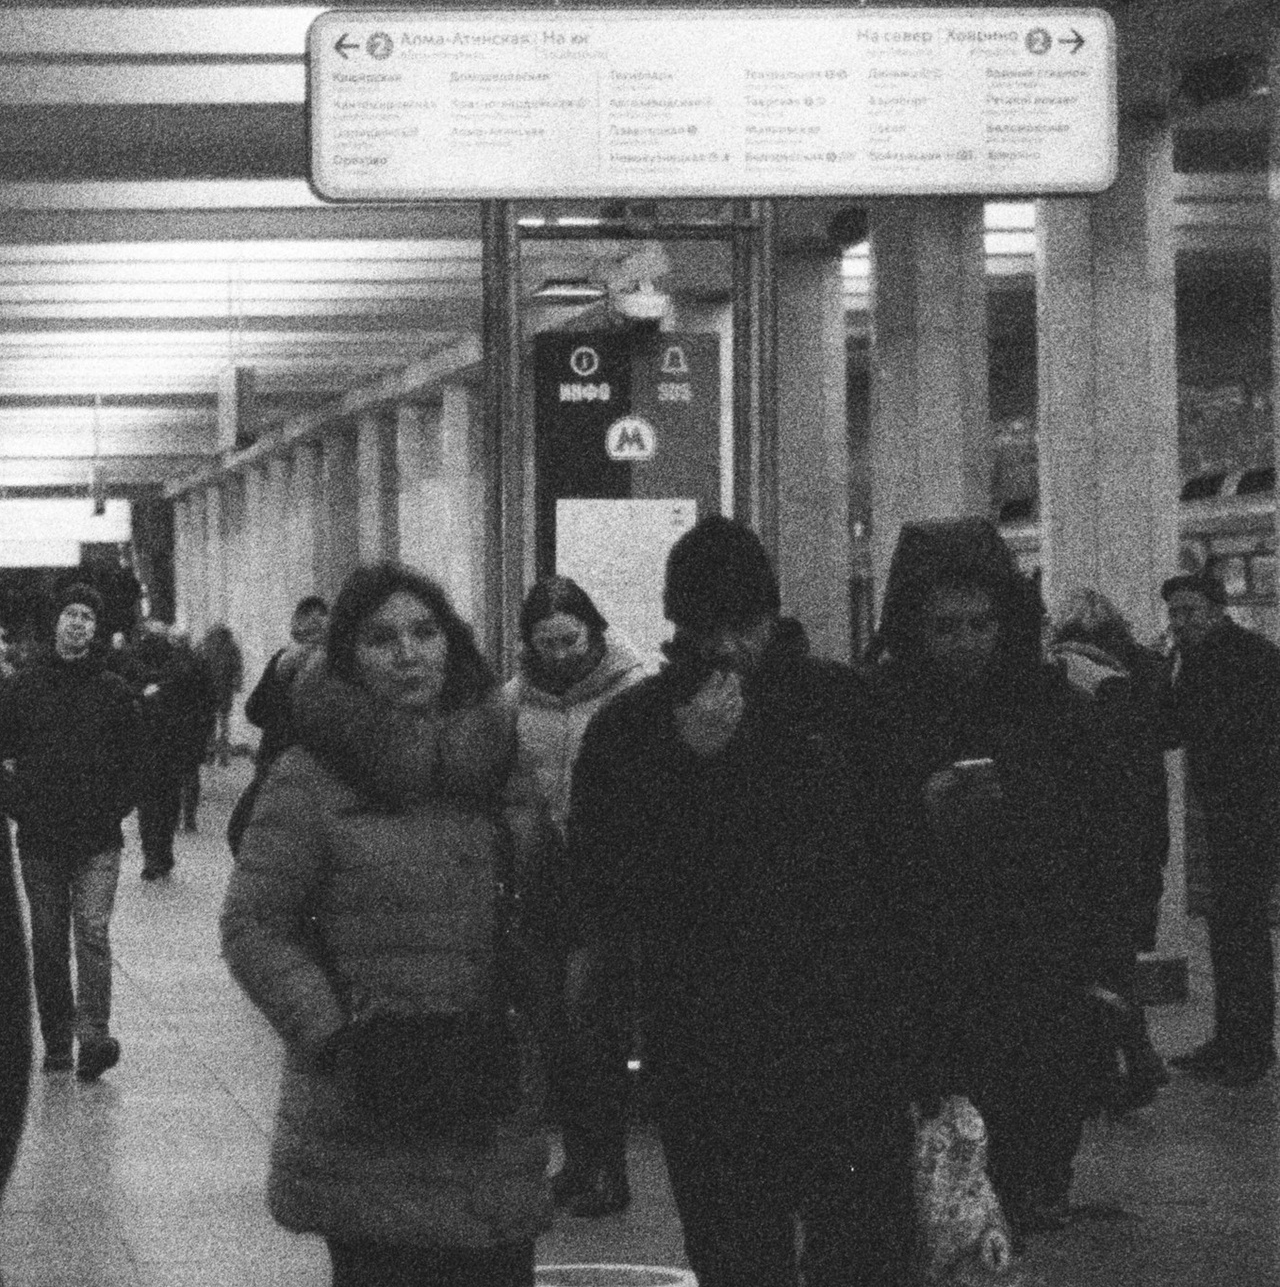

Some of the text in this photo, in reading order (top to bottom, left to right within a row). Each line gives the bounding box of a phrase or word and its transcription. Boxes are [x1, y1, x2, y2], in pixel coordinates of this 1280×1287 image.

[401, 32, 530, 46] Алма-Атинская
[543, 31, 565, 45] На
[857, 30, 879, 43] На
[884, 31, 933, 45] север
[947, 30, 1018, 45] Ховрино
[559, 382, 611, 402] ИНФО
[657, 382, 693, 402] SOS
